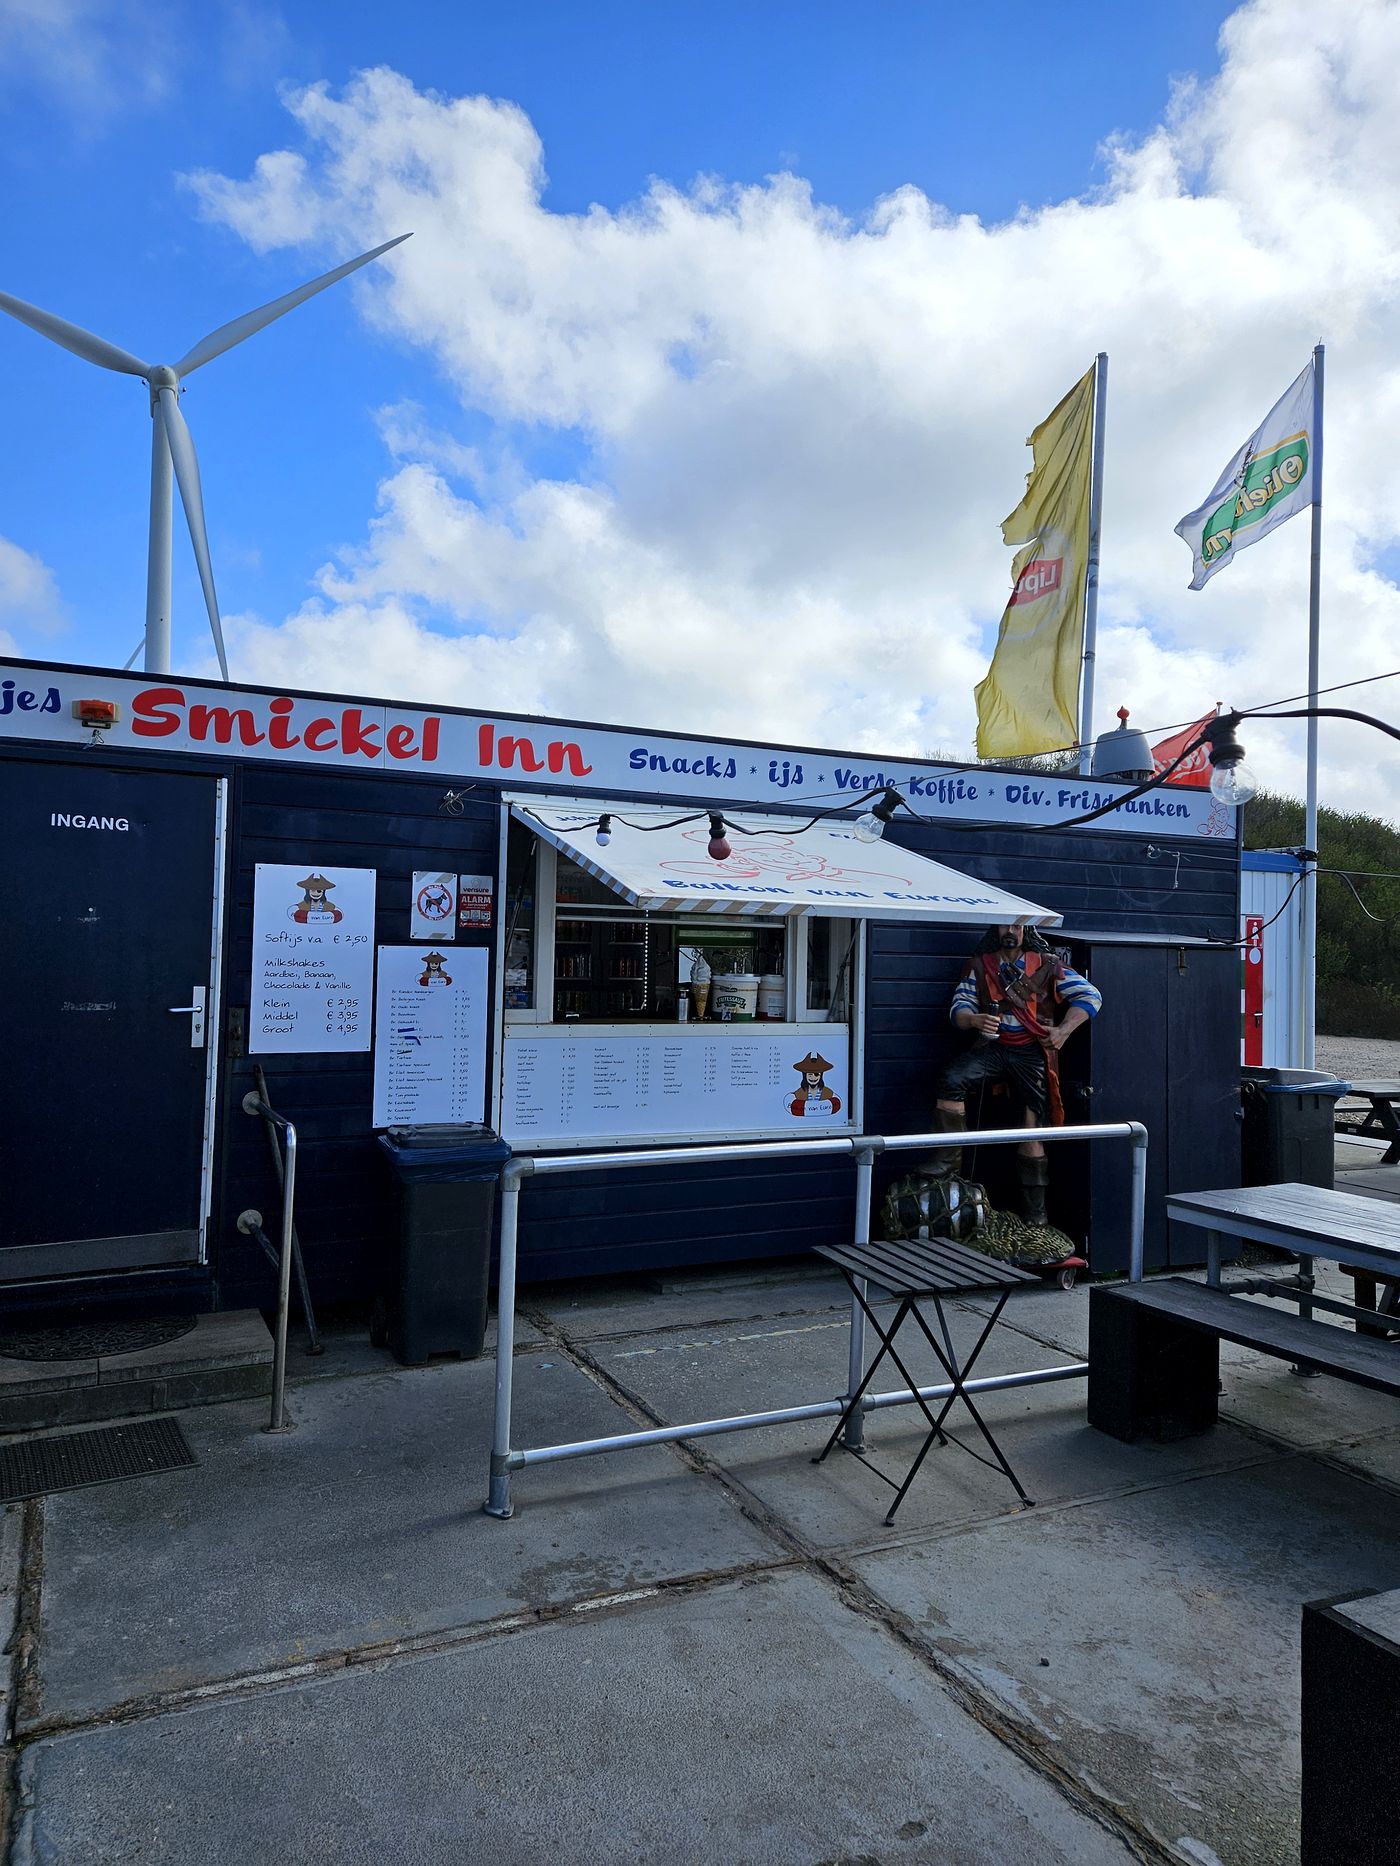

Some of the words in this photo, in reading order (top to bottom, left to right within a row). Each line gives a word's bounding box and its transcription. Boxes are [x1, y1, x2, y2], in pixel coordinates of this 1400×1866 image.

[131, 687, 441, 762] Smickel
[478, 723, 592, 777] Inn
[629, 748, 737, 779] Snacks
[768, 761, 804, 788] ijs
[834, 768, 897, 790] Verse
[909, 776, 979, 805] Koffie
[1005, 785, 1052, 807] Div.
[1057, 789, 1191, 819] Frisdanken
[50, 813, 129, 831] INGANG
[461, 896, 491, 904] ALARM
[663, 880, 794, 895] Balkon
[807, 888, 873, 899] van
[883, 892, 1000, 907] Europa
[265, 930, 303, 949] Softijs
[333, 935, 340, 944] €
[345, 935, 368, 947] 2,50
[264, 957, 326, 968] Milkshakes
[264, 970, 301, 980] Aardbei,
[304, 970, 336, 981] Banaan,
[263, 981, 311, 989] Chocolade
[314, 981, 321, 989] &
[325, 981, 352, 989] Vanille
[263, 998, 291, 1008] Klein
[326, 998, 334, 1008] €
[337, 998, 359, 1010] 2,95
[262, 1010, 298, 1021] Middel
[326, 1010, 334, 1020] €
[337, 1010, 359, 1022] 3,95
[262, 1023, 295, 1034] Groot
[326, 1023, 333, 1033] €
[336, 1022, 359, 1036] 4,95
